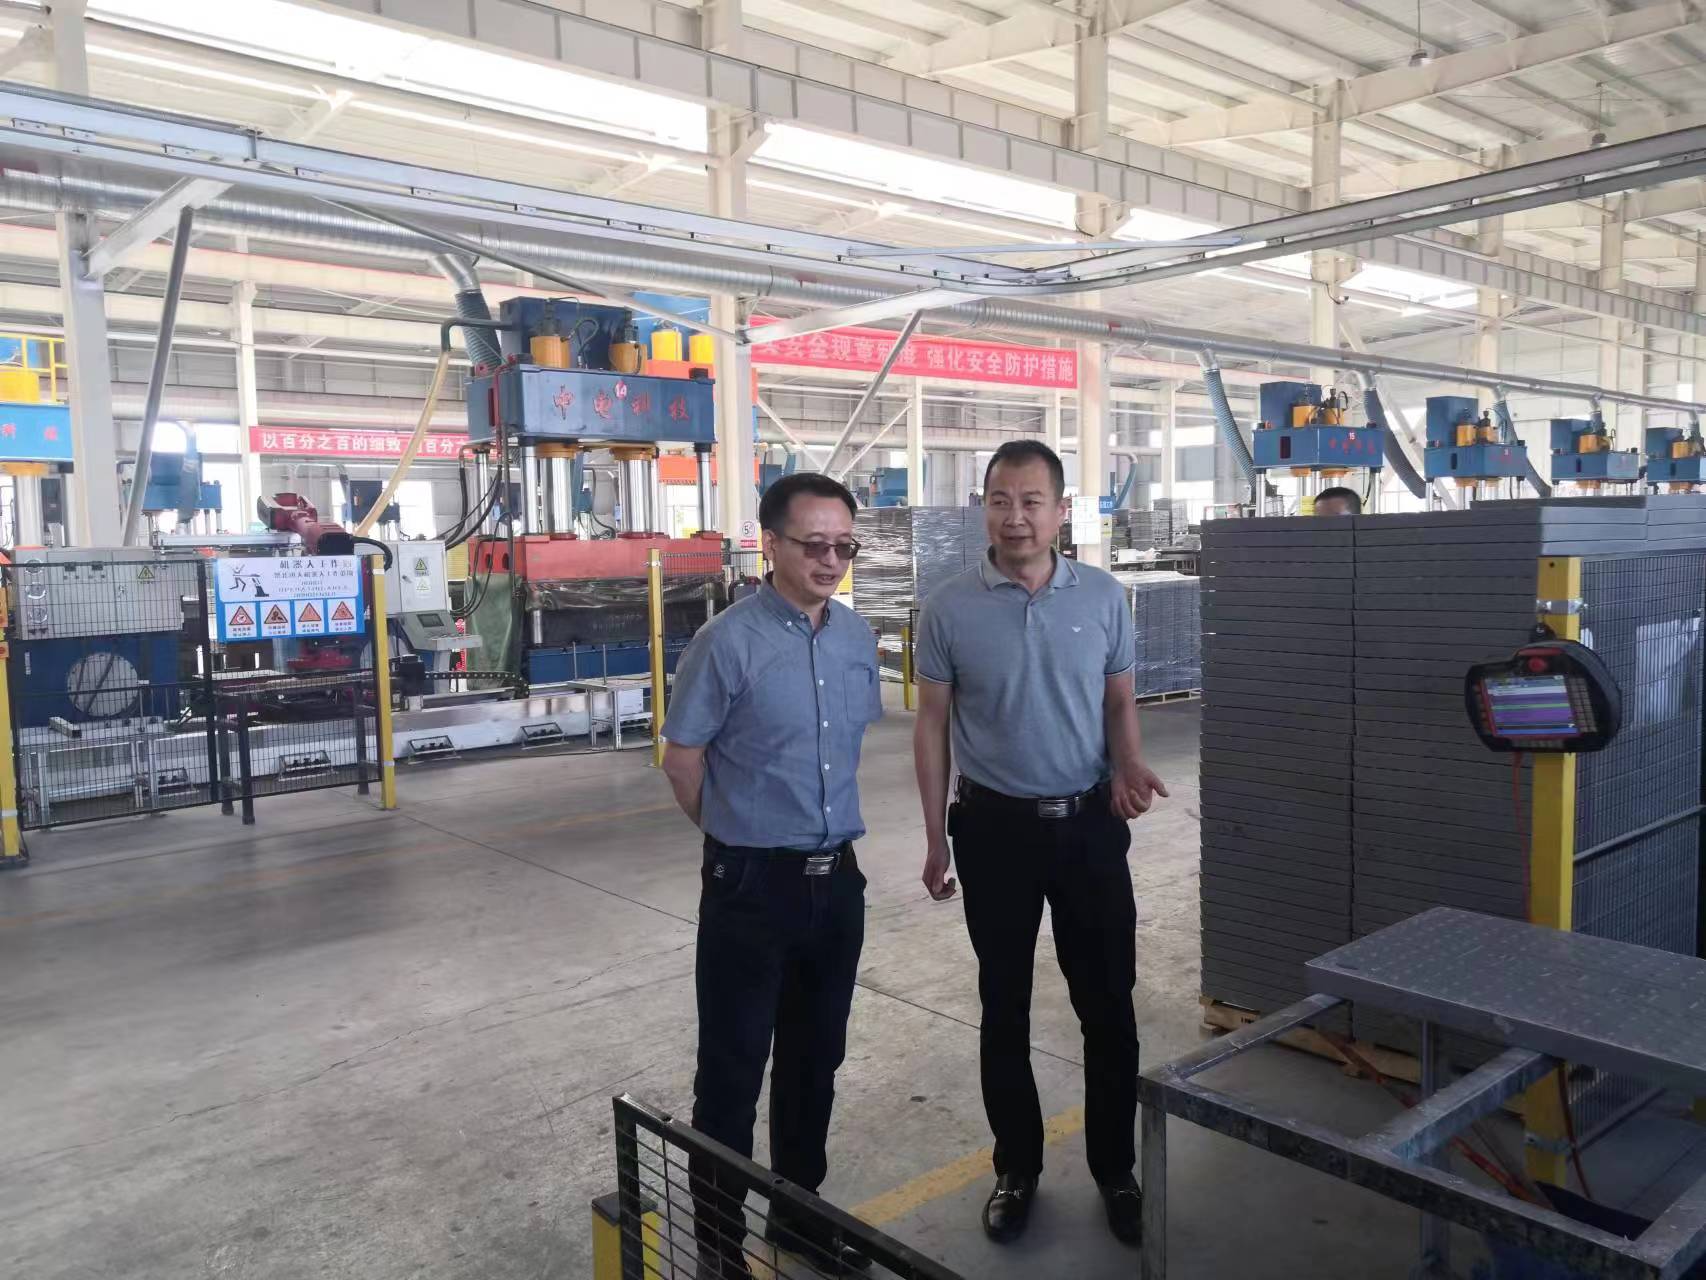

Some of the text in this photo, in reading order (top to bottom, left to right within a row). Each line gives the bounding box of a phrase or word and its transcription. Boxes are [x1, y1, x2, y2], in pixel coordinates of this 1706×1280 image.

[927, 346, 1073, 382] 强化安全防护措施
[615, 382, 628, 399] 14
